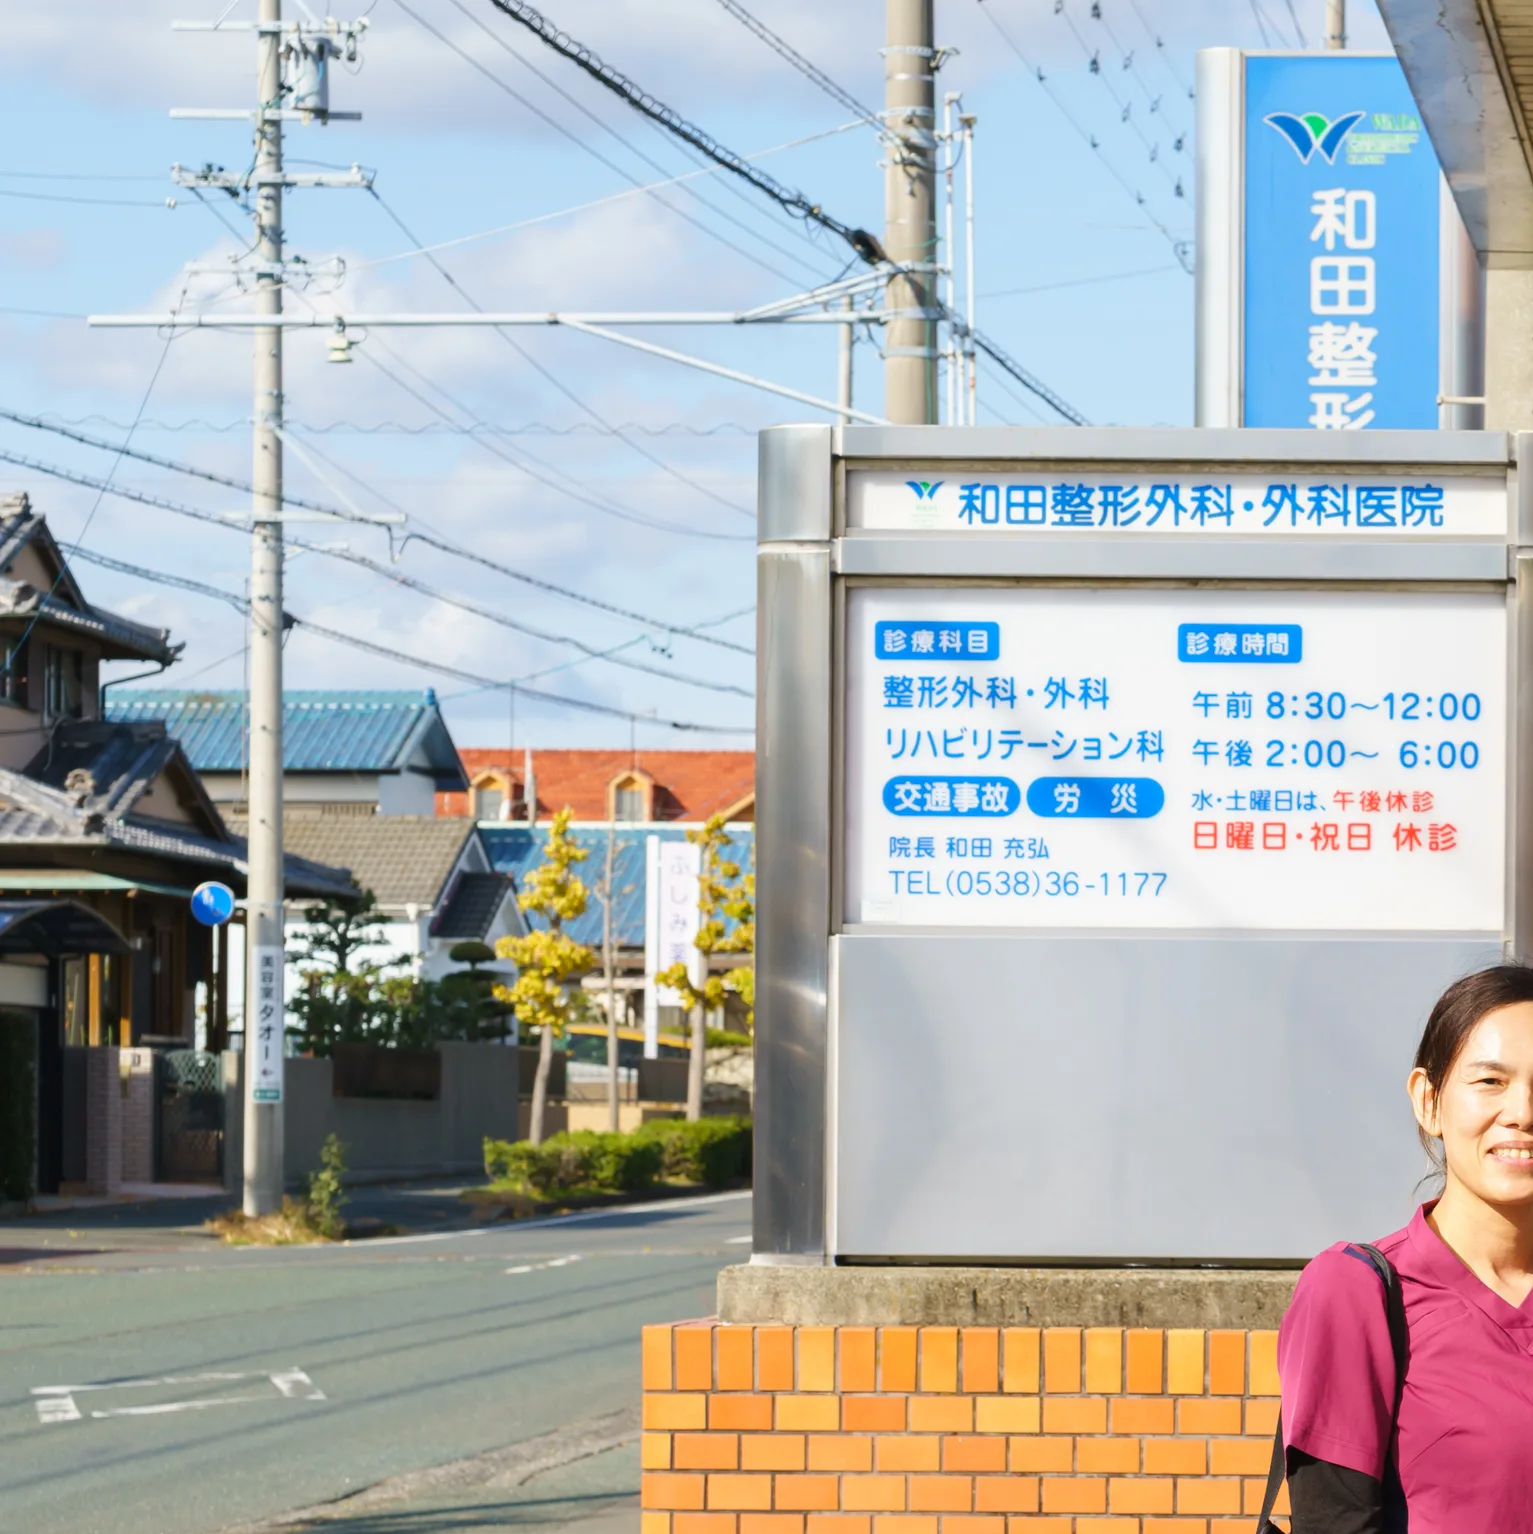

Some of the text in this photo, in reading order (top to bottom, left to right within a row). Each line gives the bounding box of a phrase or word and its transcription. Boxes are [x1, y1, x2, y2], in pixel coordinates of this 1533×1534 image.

[957, 483, 1444, 527] 和田整形外科・外科医院
[882, 629, 989, 653] 診療科目
[1185, 632, 1290, 656] 診療時間
[882, 675, 1110, 710] 整形外科・外科
[1192, 690, 1253, 719] 午前
[886, 726, 1165, 763] リハビリテーション科
[1192, 738, 1253, 767] 午後
[893, 781, 1010, 813] 交通事故
[888, 836, 936, 859] 院長
[946, 836, 993, 859] 和田
[1193, 820, 1458, 852] 日曜日・祝日 休診
[888, 870, 1168, 898] TEL(0538)36-1177
